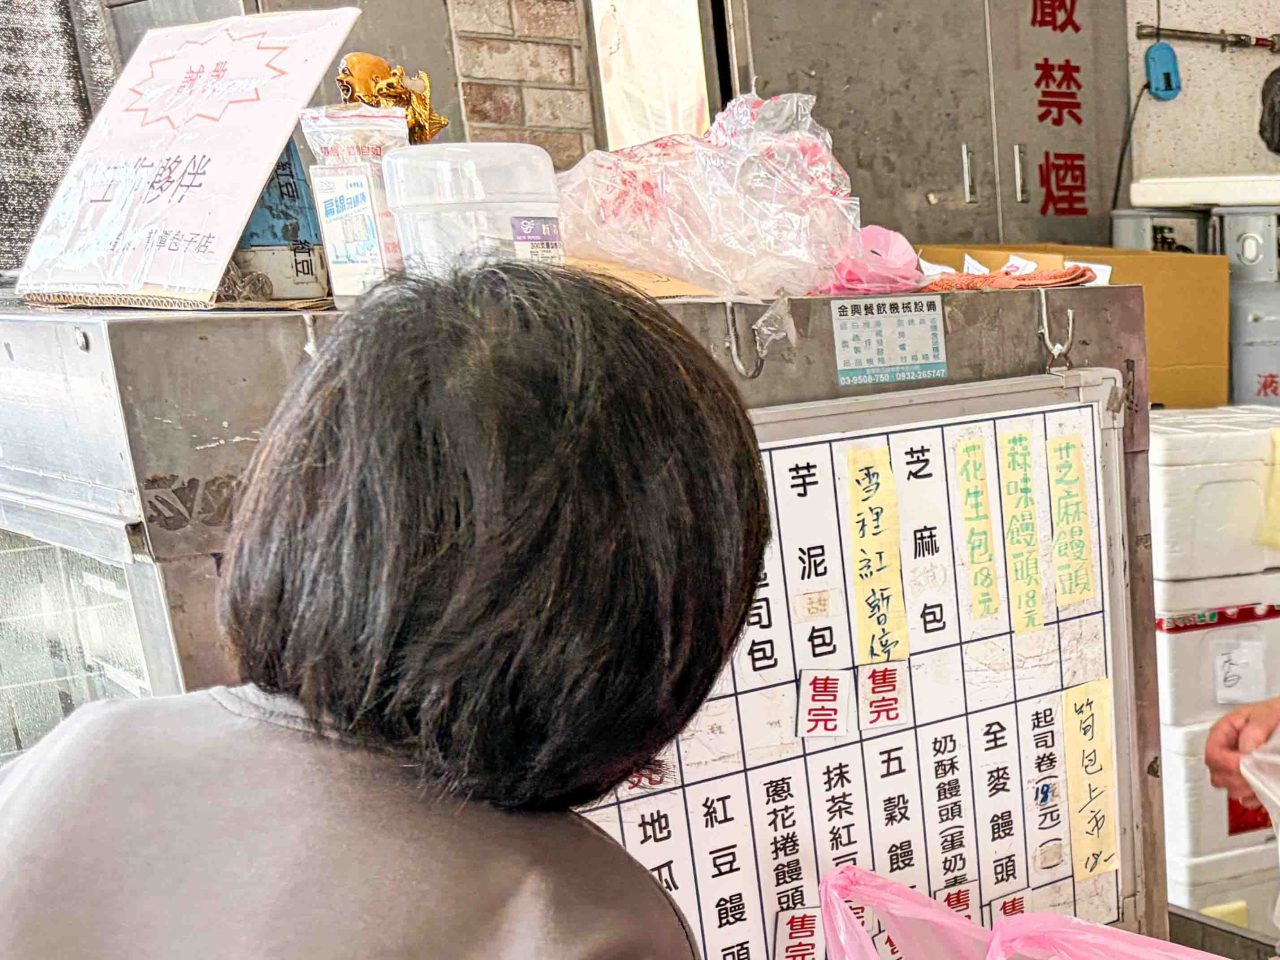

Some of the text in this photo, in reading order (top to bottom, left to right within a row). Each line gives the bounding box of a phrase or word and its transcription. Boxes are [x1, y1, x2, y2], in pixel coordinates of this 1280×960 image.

[290, 239, 314, 277] 紅豆
[837, 301, 937, 317] 金興餐飲機械設備
[1256, 373, 1280, 397] 液
[904, 446, 946, 634] 芝麻包
[1054, 442, 1091, 595] 芝麻饅頭
[788, 462, 837, 658] 芋泥包
[746, 572, 778, 672] 司包
[806, 675, 840, 734] 售完
[867, 667, 900, 724] 售完
[879, 746, 915, 888] 五穀饅
[983, 721, 1018, 885] 全麥饅頭
[944, 889, 971, 920] 售
